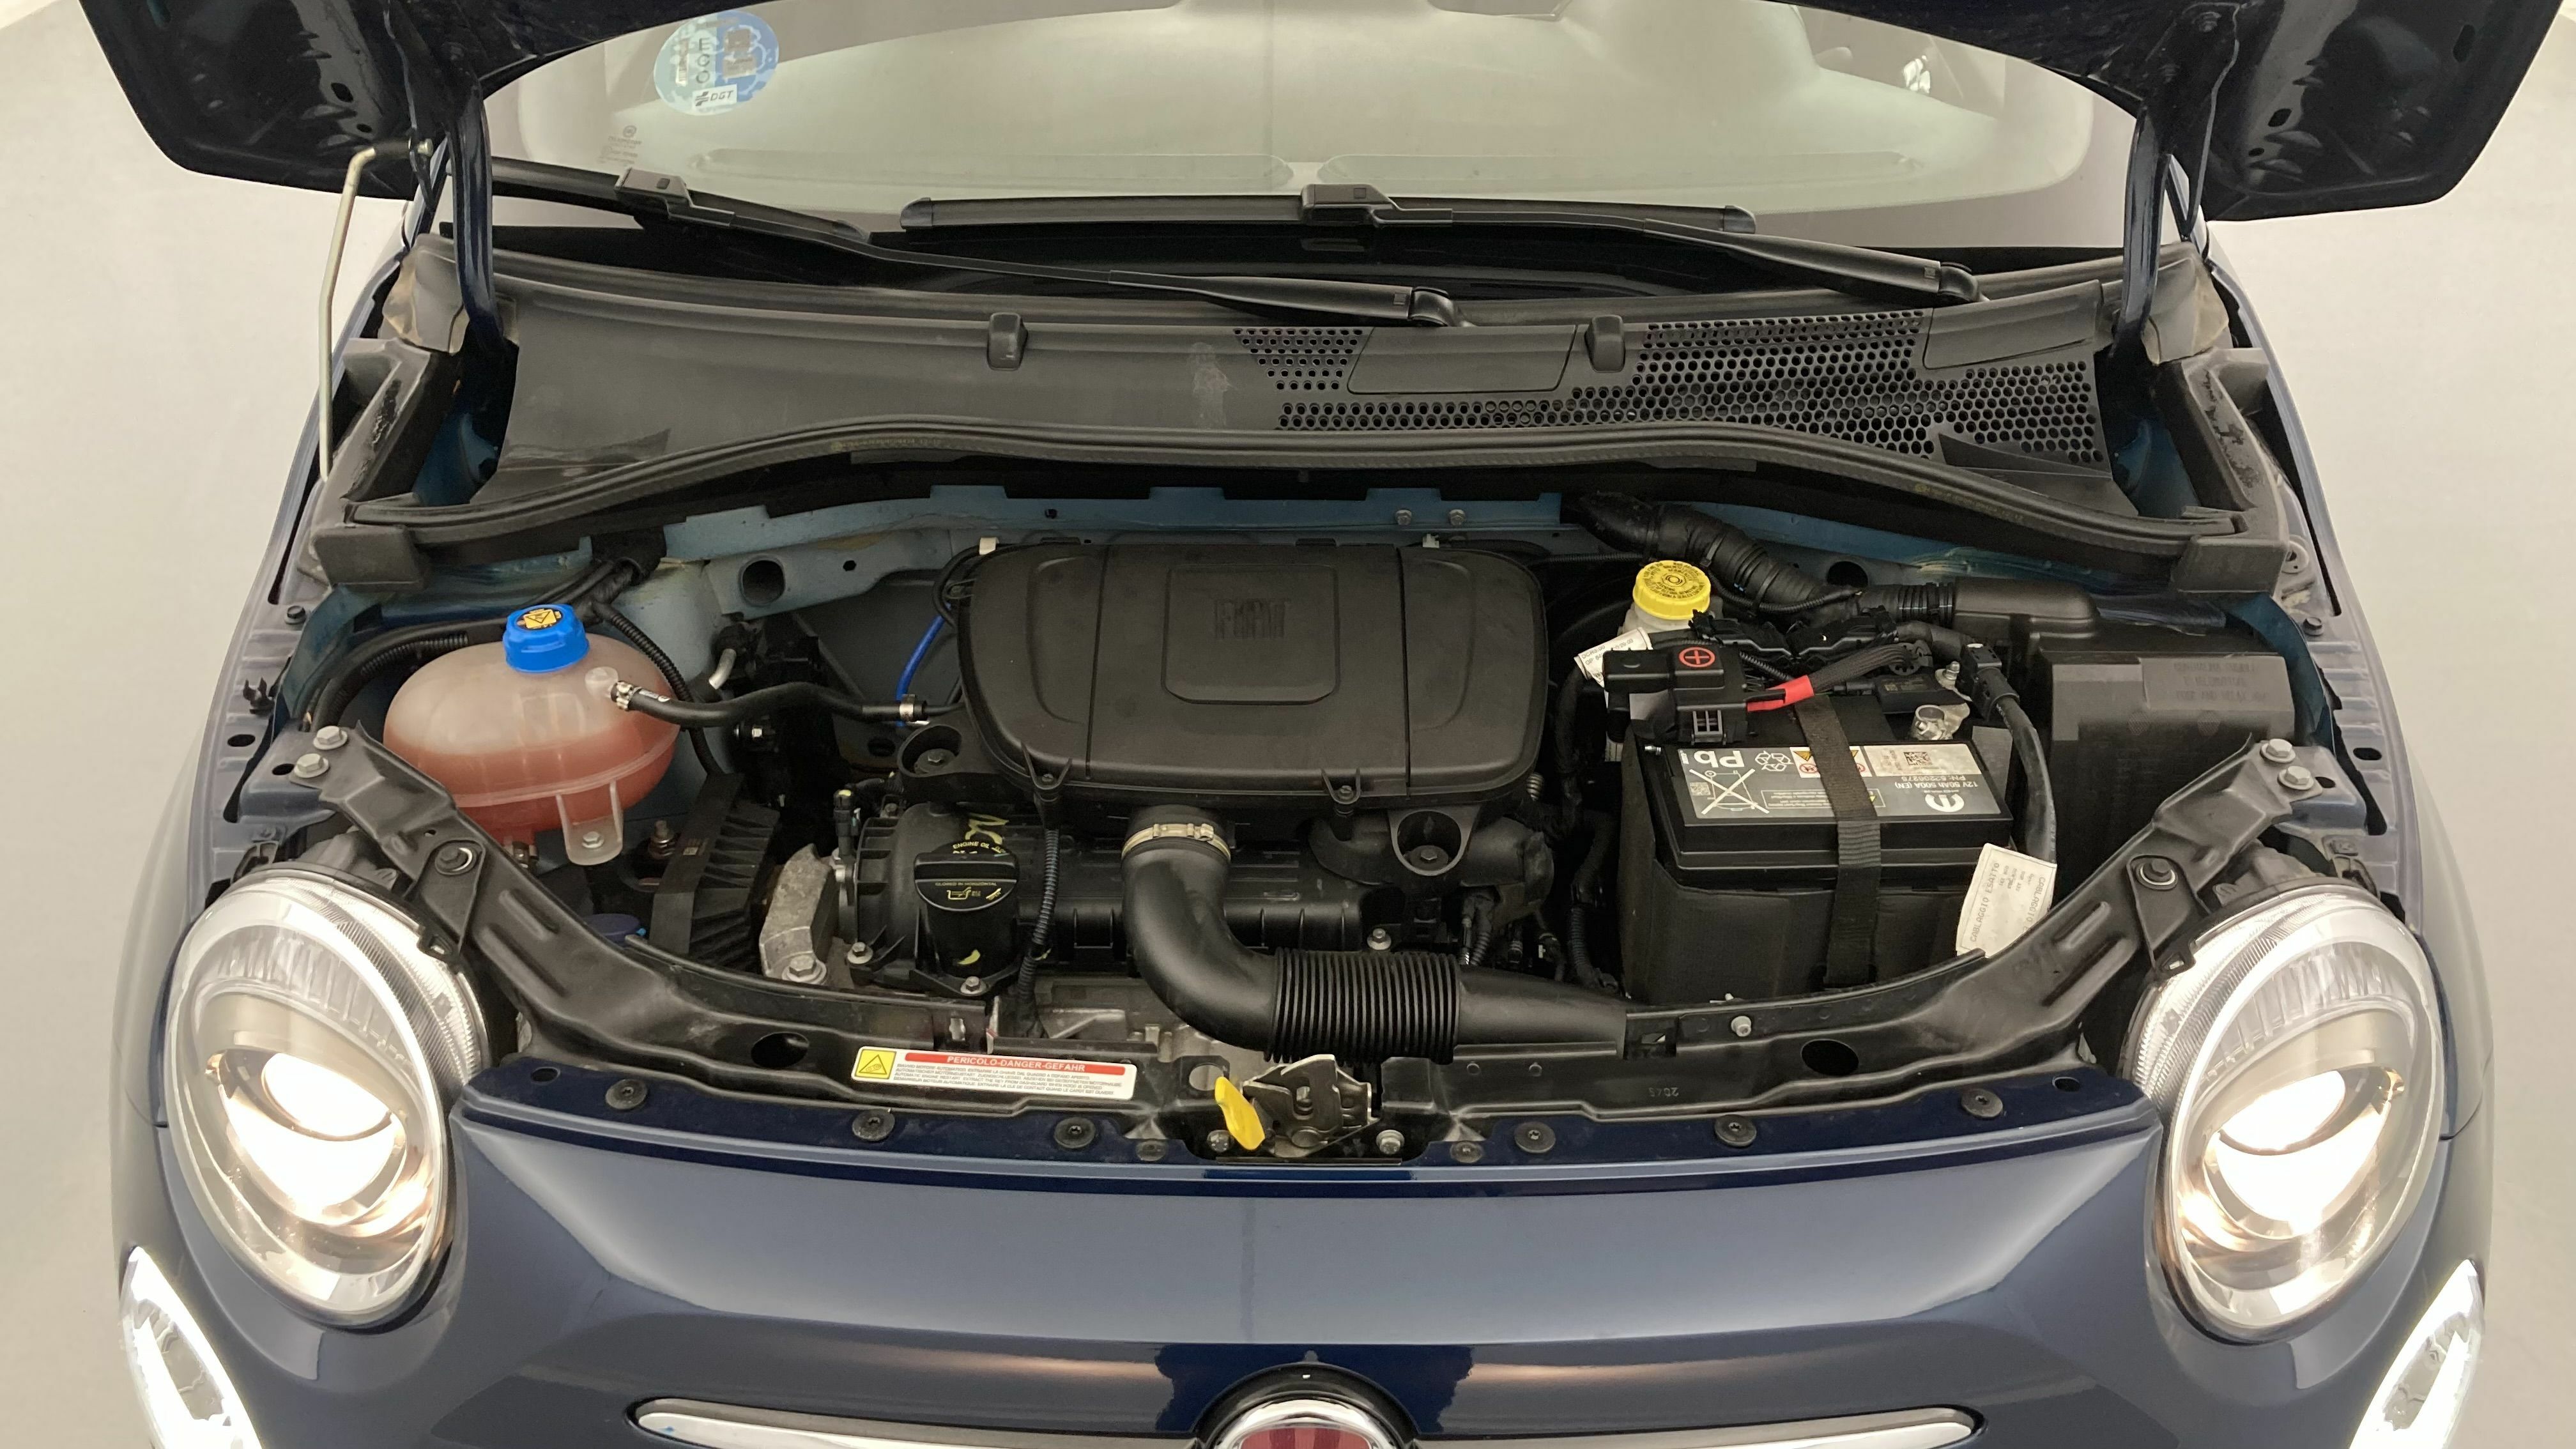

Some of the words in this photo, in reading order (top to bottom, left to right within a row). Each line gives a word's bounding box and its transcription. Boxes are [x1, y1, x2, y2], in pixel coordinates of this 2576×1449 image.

[710, 90, 733, 101] DGT
[1694, 750, 1745, 768] Pb
[953, 841, 979, 849] ENGINE
[2027, 876, 2046, 923] CABLAGGIO
[1970, 897, 1989, 942] CABLAGGIO
[947, 1055, 1085, 1072] PERICOLO-DANGER-GEFAHR
